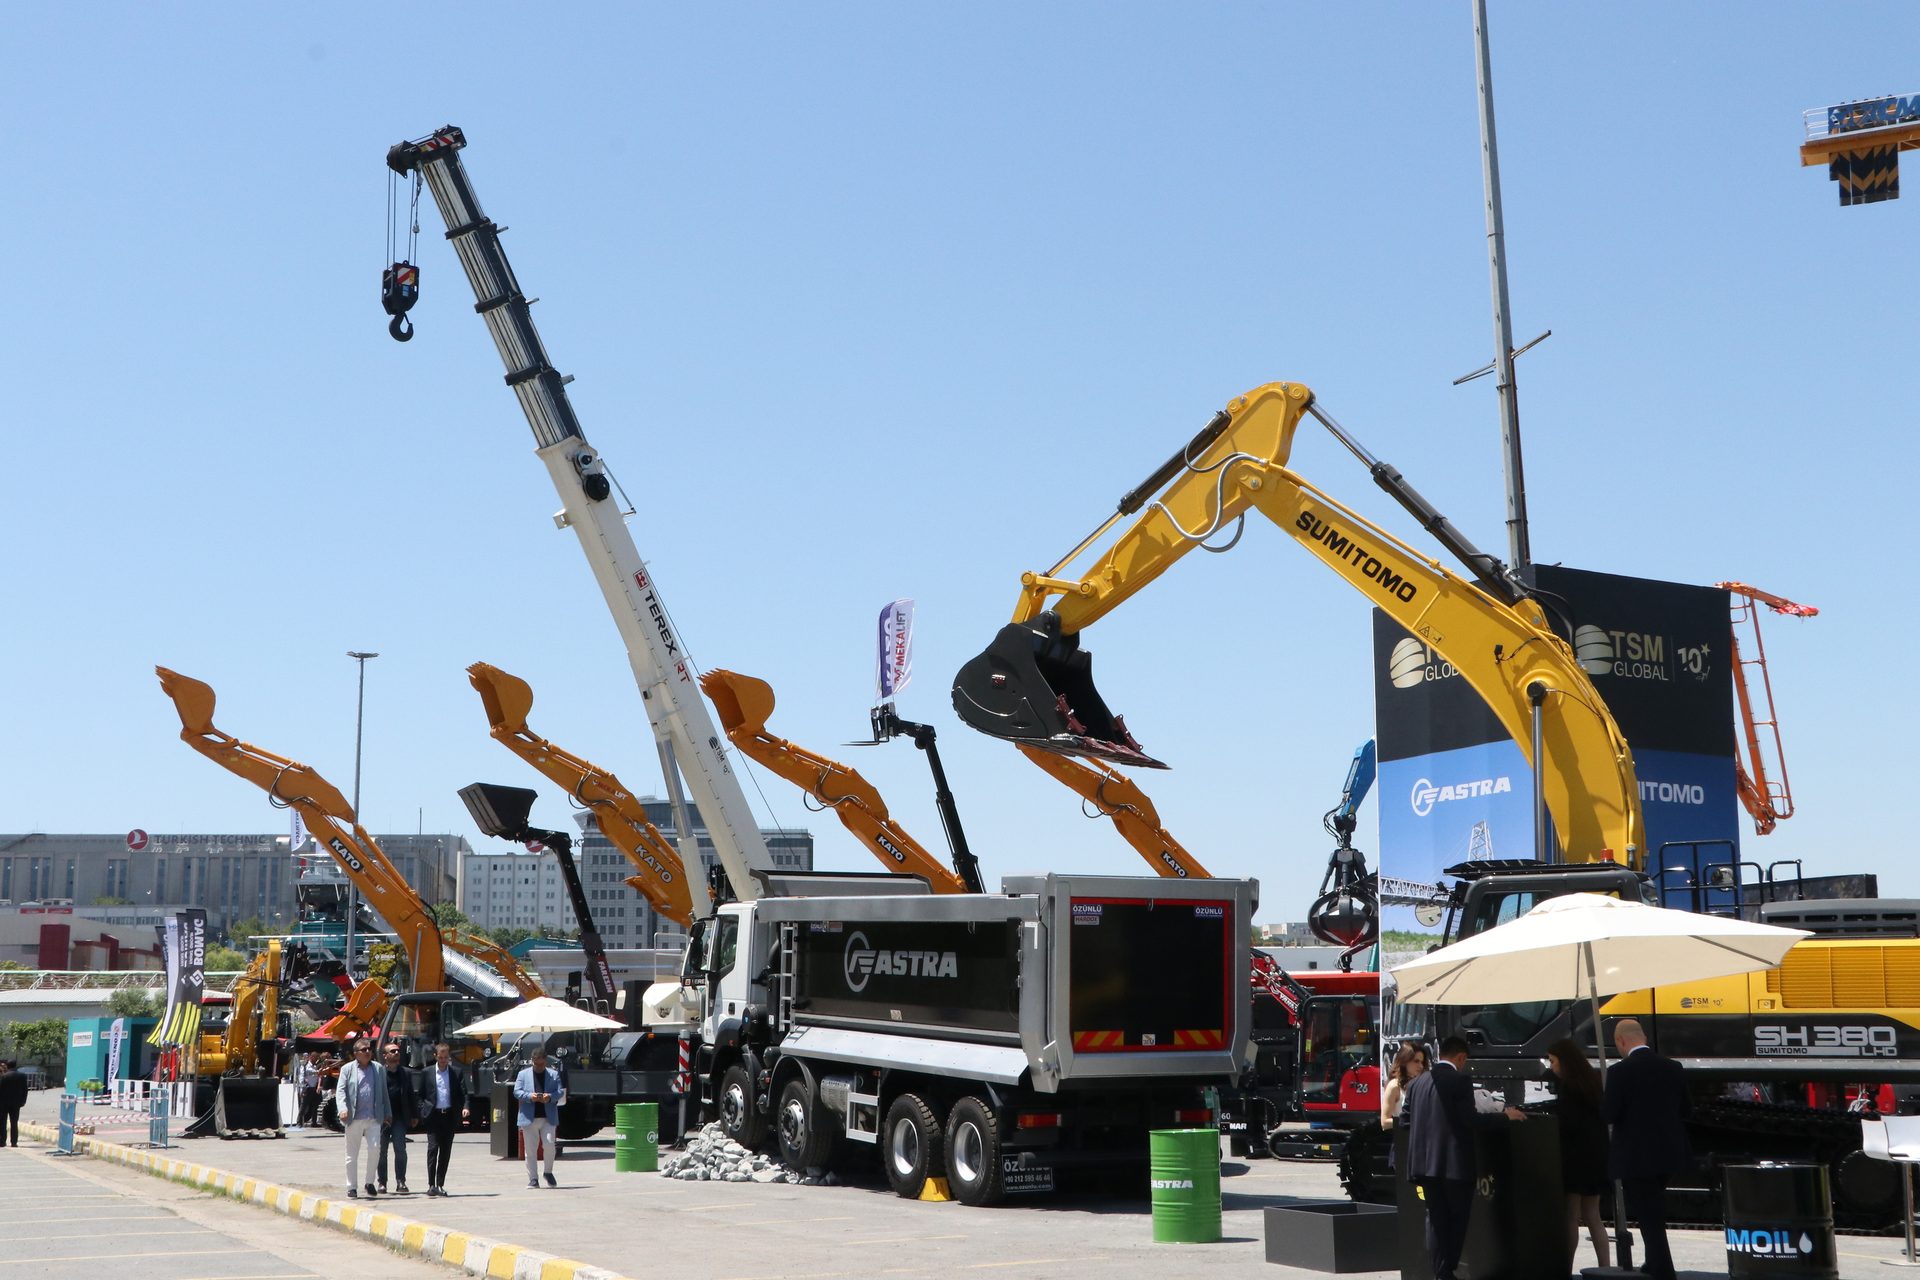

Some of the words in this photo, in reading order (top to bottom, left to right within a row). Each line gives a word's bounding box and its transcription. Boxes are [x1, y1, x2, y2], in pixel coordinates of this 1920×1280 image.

[1296, 511, 1418, 604] SUMITOMO
[644, 589, 678, 656] TEREX
[1609, 630, 1664, 663] TSM
[1425, 662, 1459, 682] GLOB
[1613, 660, 1670, 681] GLOBAL
[1436, 776, 1512, 802] ASTRA
[1637, 781, 1705, 804] ITOMO
[155, 834, 209, 845] TURKISH
[211, 834, 266, 845] TECHNIC
[878, 836, 904, 861] KATO
[330, 838, 362, 871] KATO
[632, 843, 674, 884] KATO
[1163, 852, 1187, 877] KATO
[1072, 904, 1102, 912] ÖZÜNLÜ
[1195, 906, 1223, 915] ÖZÜNLÜ
[871, 950, 958, 979] ASTRA
[1754, 1025, 1809, 1046] SH
[1813, 1025, 1897, 1047] 380
[1861, 1046, 1897, 1057] LHD
